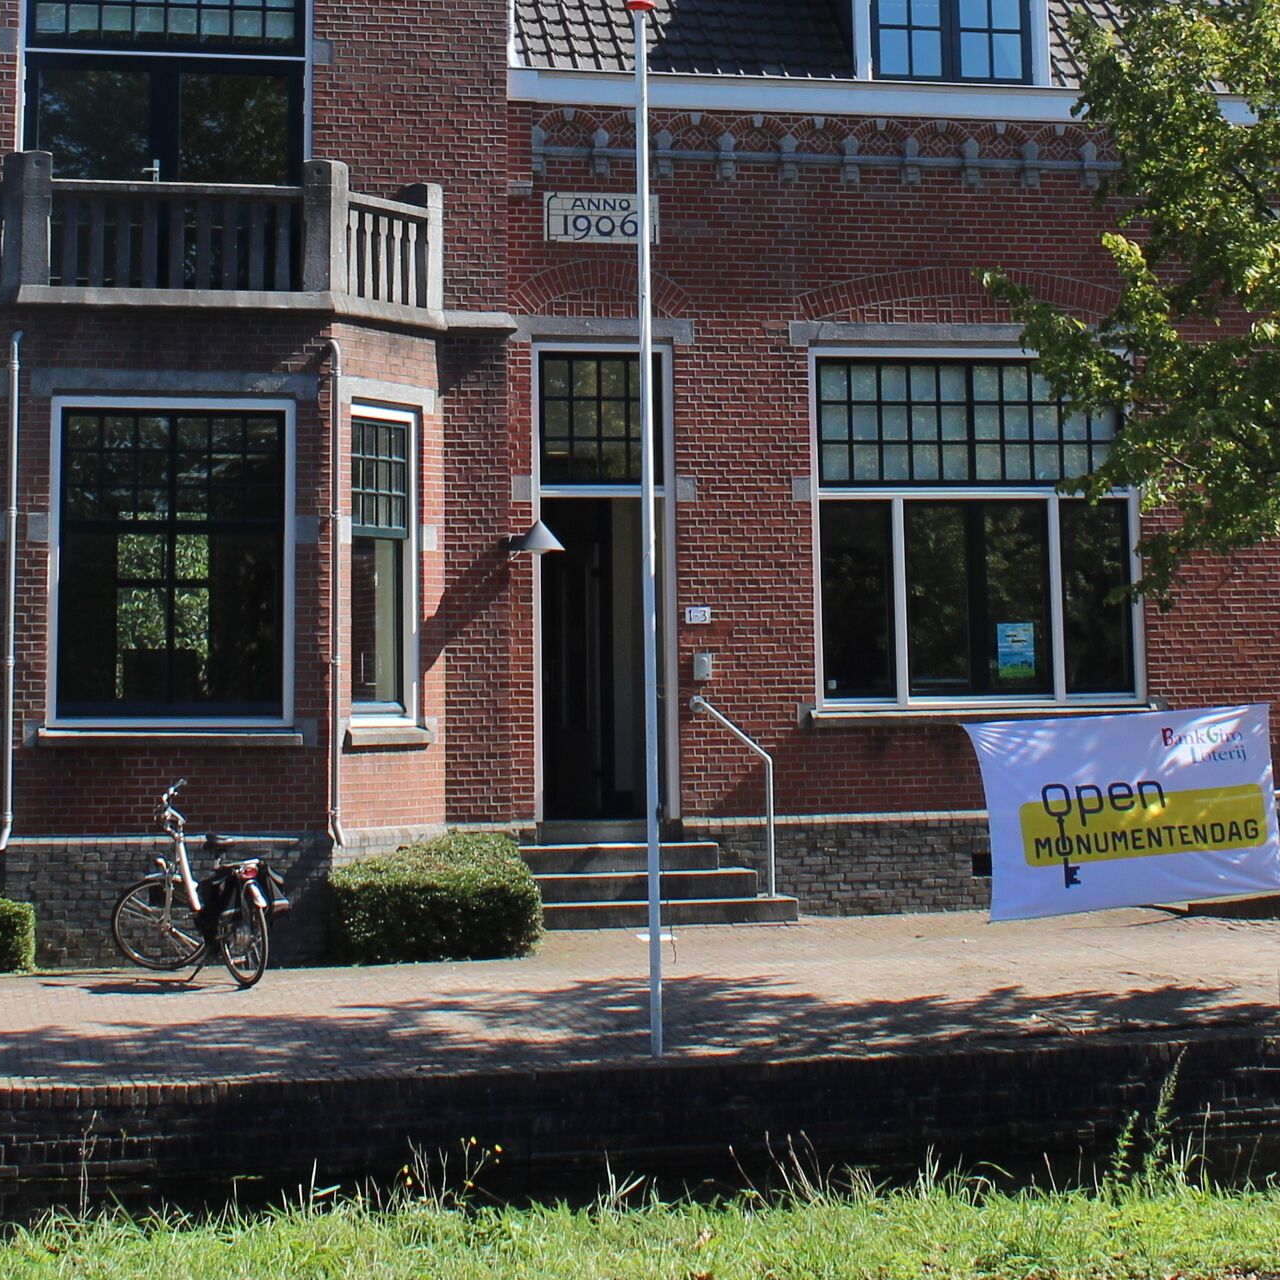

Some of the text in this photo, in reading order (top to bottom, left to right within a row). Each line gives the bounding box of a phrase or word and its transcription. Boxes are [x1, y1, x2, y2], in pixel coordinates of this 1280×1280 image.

[571, 198, 631, 211] ANNO
[563, 211, 638, 240] 1906
[688, 609, 707, 622] 1-3
[1161, 725, 1243, 747] BankGiro
[1190, 744, 1247, 764] Loterij
[1034, 818, 1260, 859] MONUMENTENDAG
